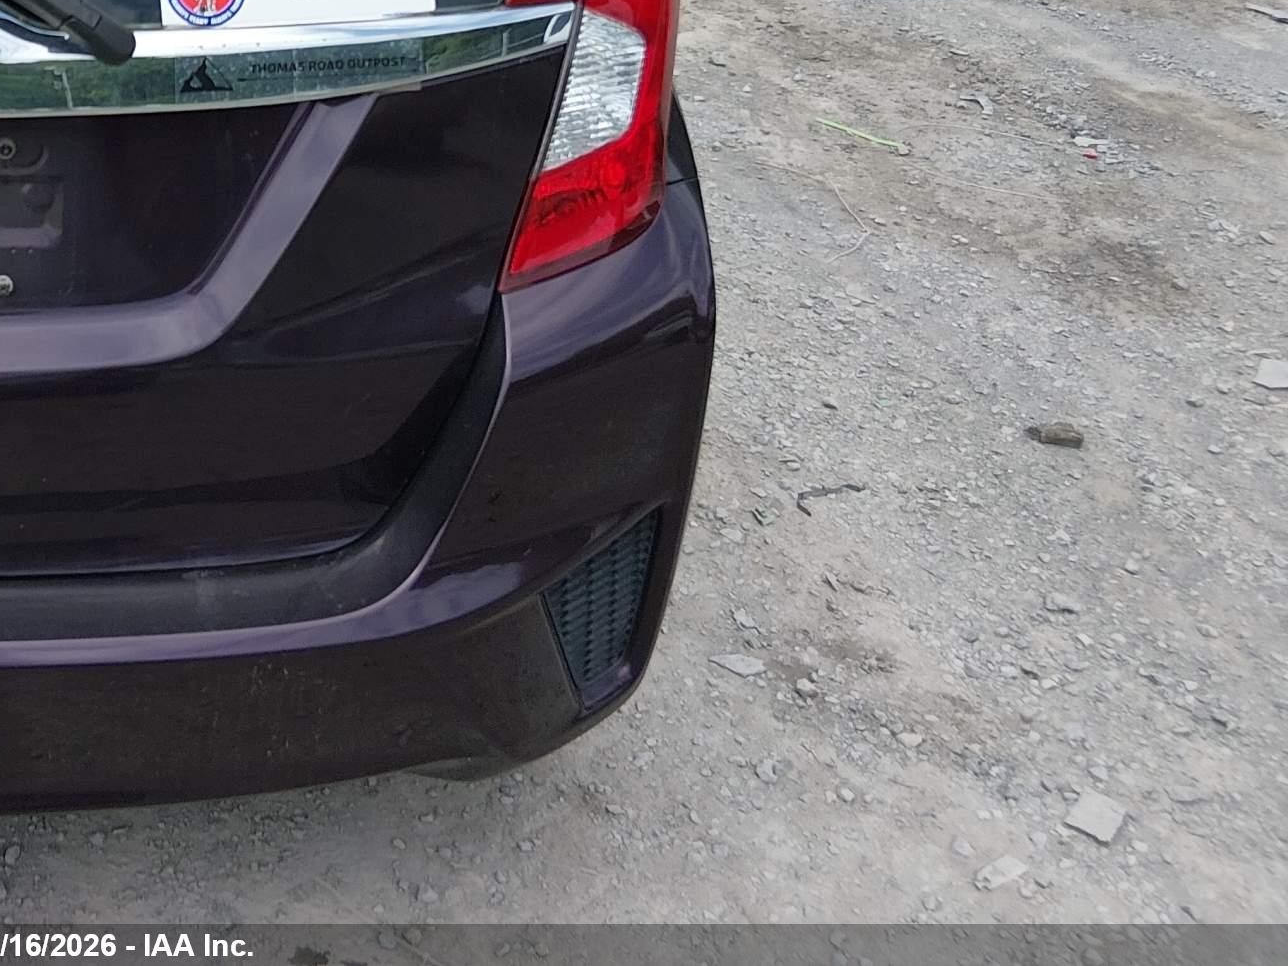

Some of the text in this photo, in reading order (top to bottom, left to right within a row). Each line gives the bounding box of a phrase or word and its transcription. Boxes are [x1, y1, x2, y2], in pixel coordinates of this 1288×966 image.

[251, 56, 406, 74] THOMAS ROAD OUTPOST
